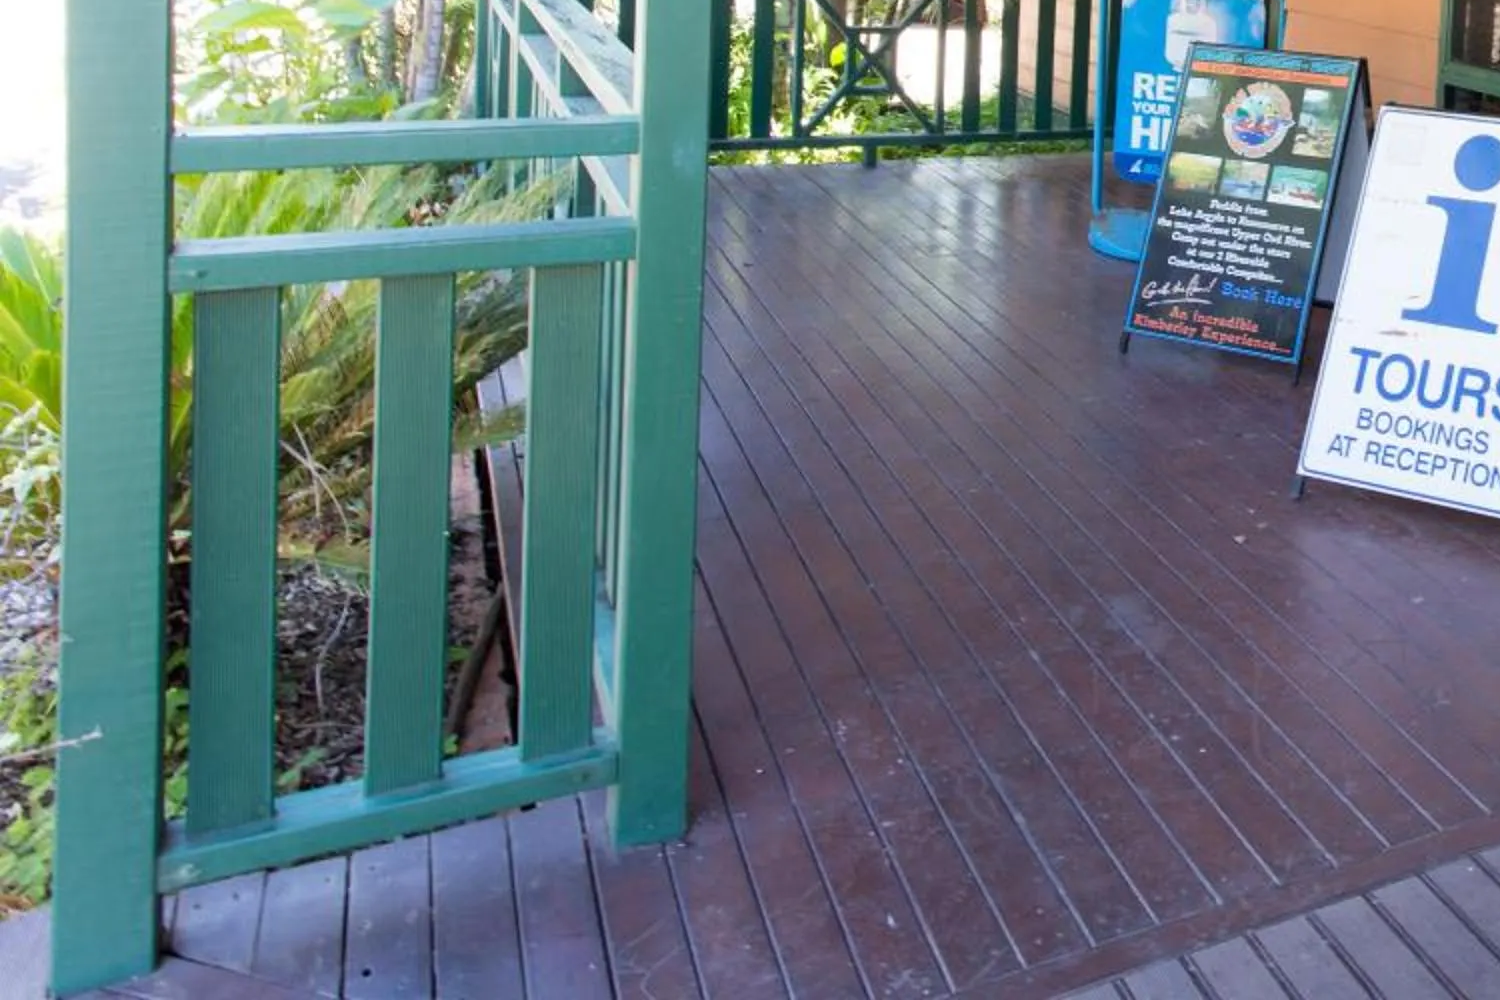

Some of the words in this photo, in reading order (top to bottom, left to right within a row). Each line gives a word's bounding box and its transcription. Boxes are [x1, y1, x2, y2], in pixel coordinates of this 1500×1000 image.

[1132, 101, 1171, 116] YOUR
[1172, 232, 1199, 246] Camp
[1249, 242, 1264, 254] the
[1232, 227, 1262, 242] Upper
[1219, 281, 1258, 298] Book
[1264, 289, 1303, 309] Here
[1134, 313, 1199, 338] Kimberley
[1169, 306, 1188, 320] An
[1192, 312, 1259, 333] Incredible
[1356, 407, 1490, 454] BOOKINGS
[1327, 433, 1357, 457] AT
